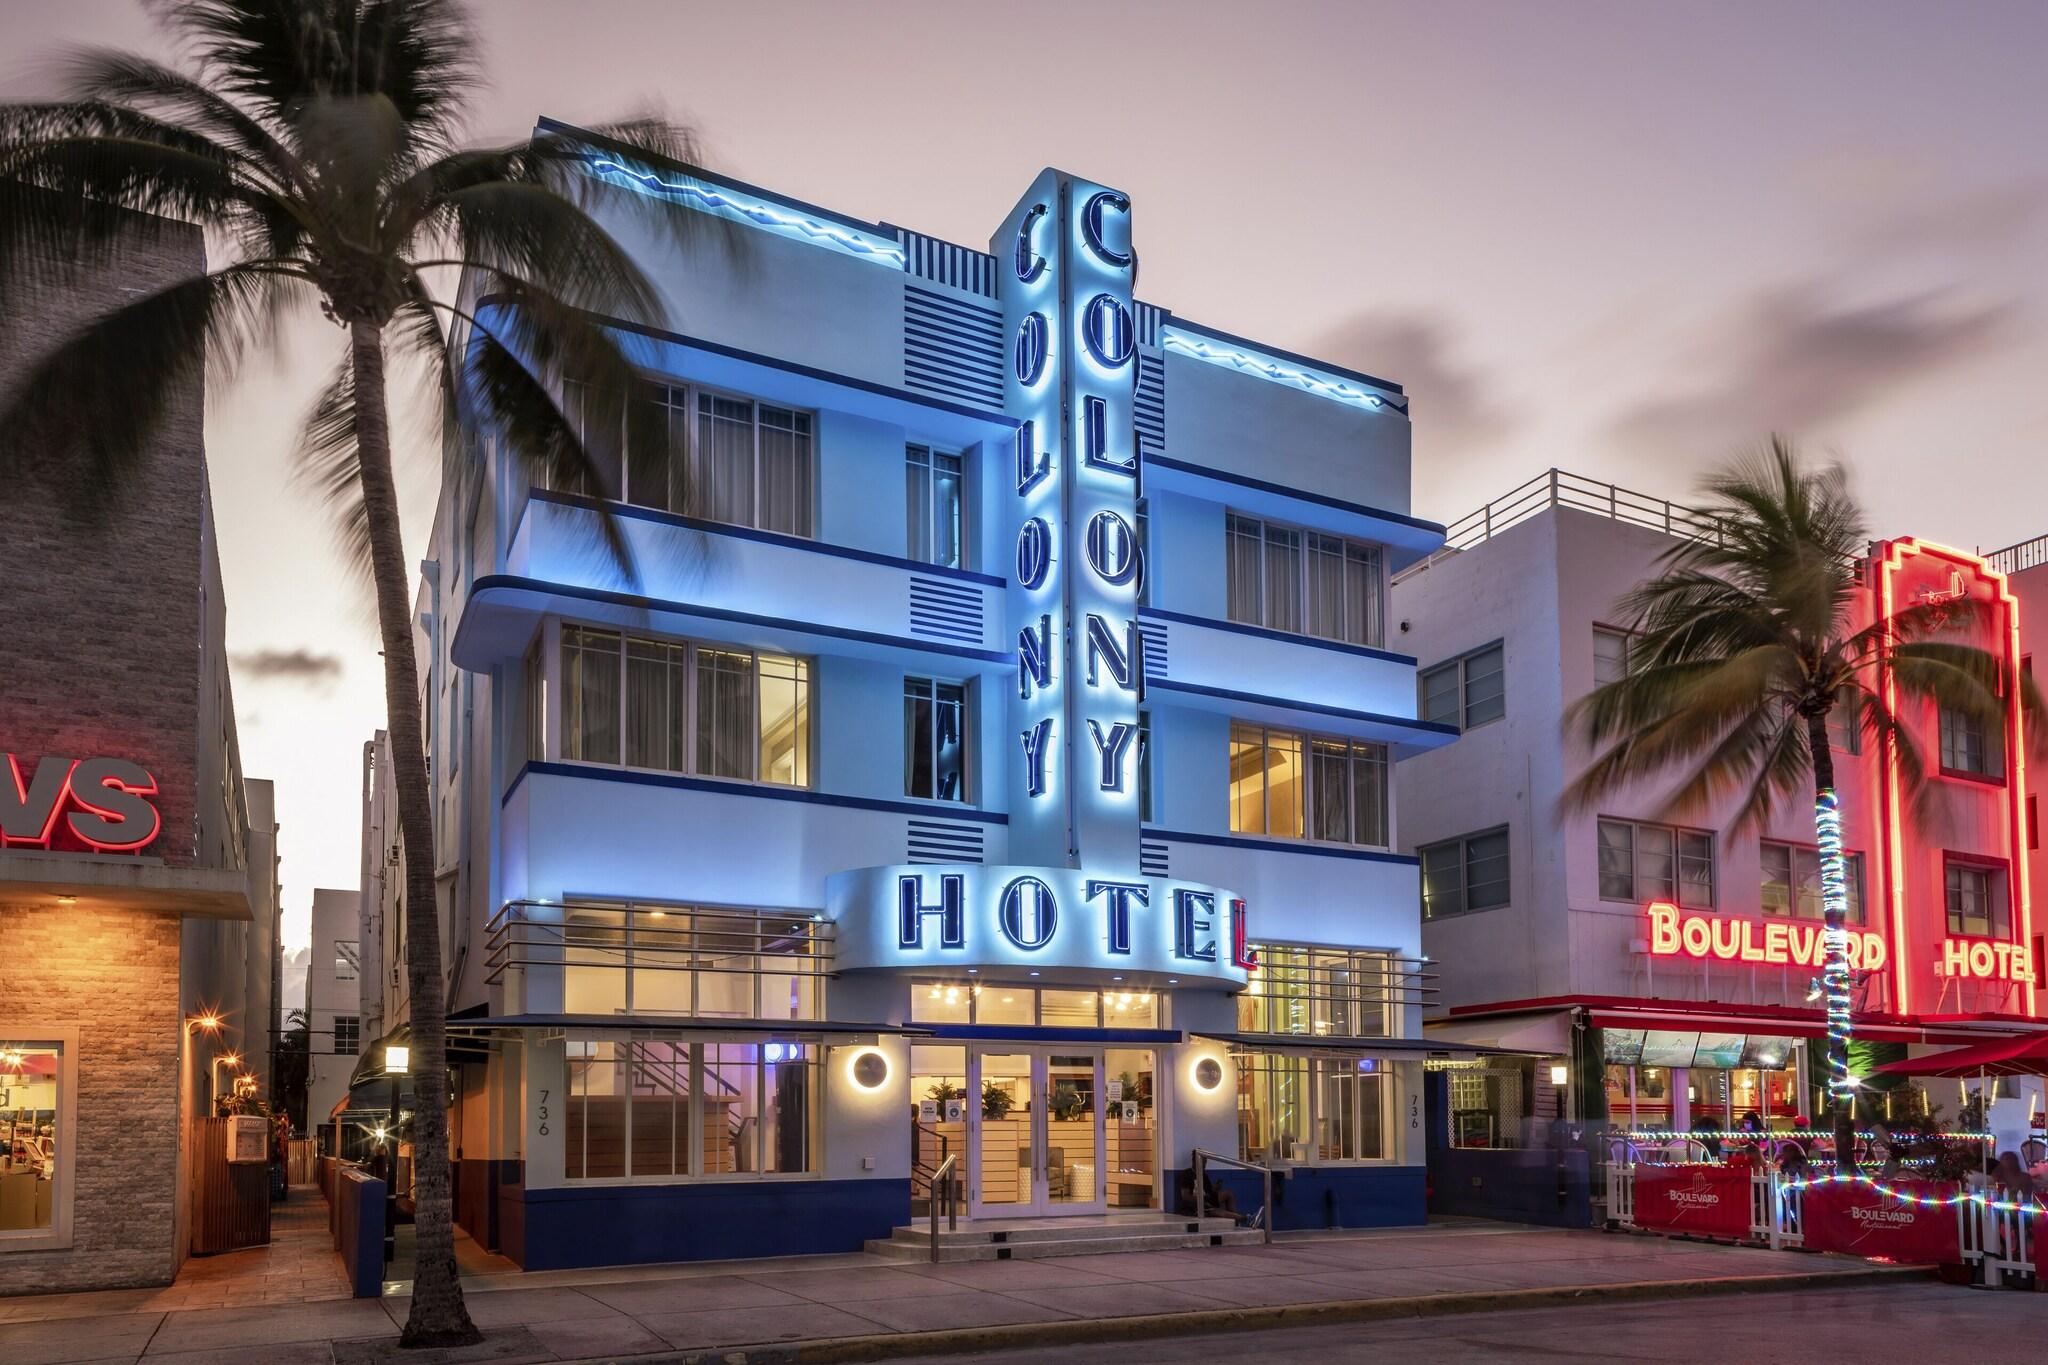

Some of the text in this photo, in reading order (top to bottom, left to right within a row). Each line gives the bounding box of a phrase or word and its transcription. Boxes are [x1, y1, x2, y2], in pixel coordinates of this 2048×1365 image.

[1014, 203, 1054, 798] COLONY
[1081, 191, 1138, 794] COLONY
[898, 873, 1258, 971] HOTEL
[1945, 938, 2036, 982] HOTEL
[538, 1089, 550, 1136] 736
[1411, 1094, 1419, 1129] 736
[1669, 1189, 1720, 1204] BOULEVARD
[1851, 1206, 1915, 1223] BOULEVARD
